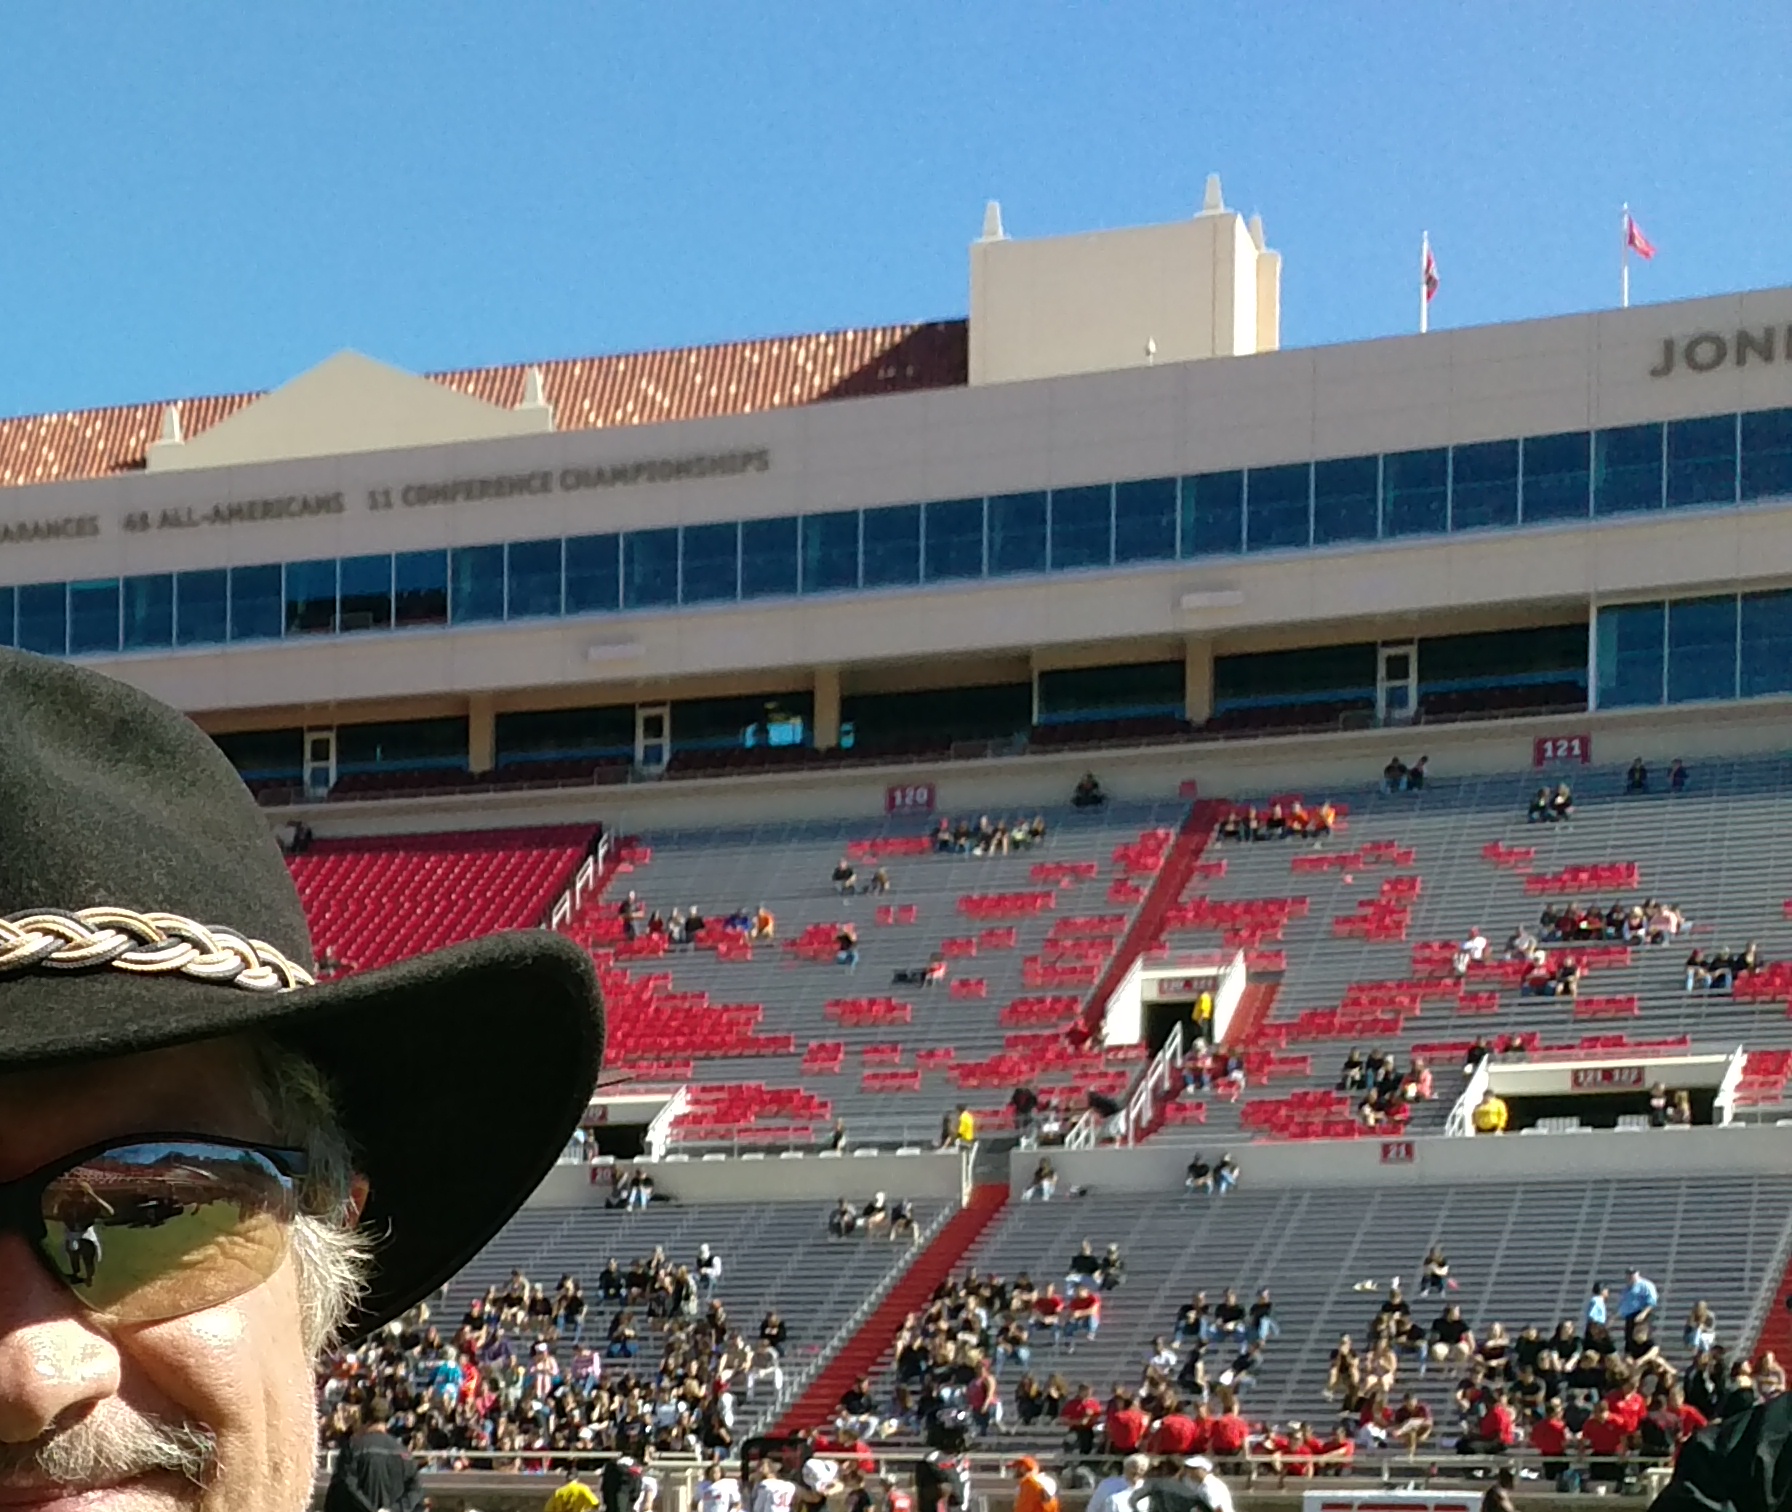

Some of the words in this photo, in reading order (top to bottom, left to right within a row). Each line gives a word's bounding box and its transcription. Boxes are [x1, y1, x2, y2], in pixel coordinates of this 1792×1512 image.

[158, 491, 344, 530] ALL-AMERICANS
[401, 470, 553, 507] CONFERENCE
[560, 449, 770, 493] CHAMPIONSHIPS
[1544, 738, 1581, 758] 121
